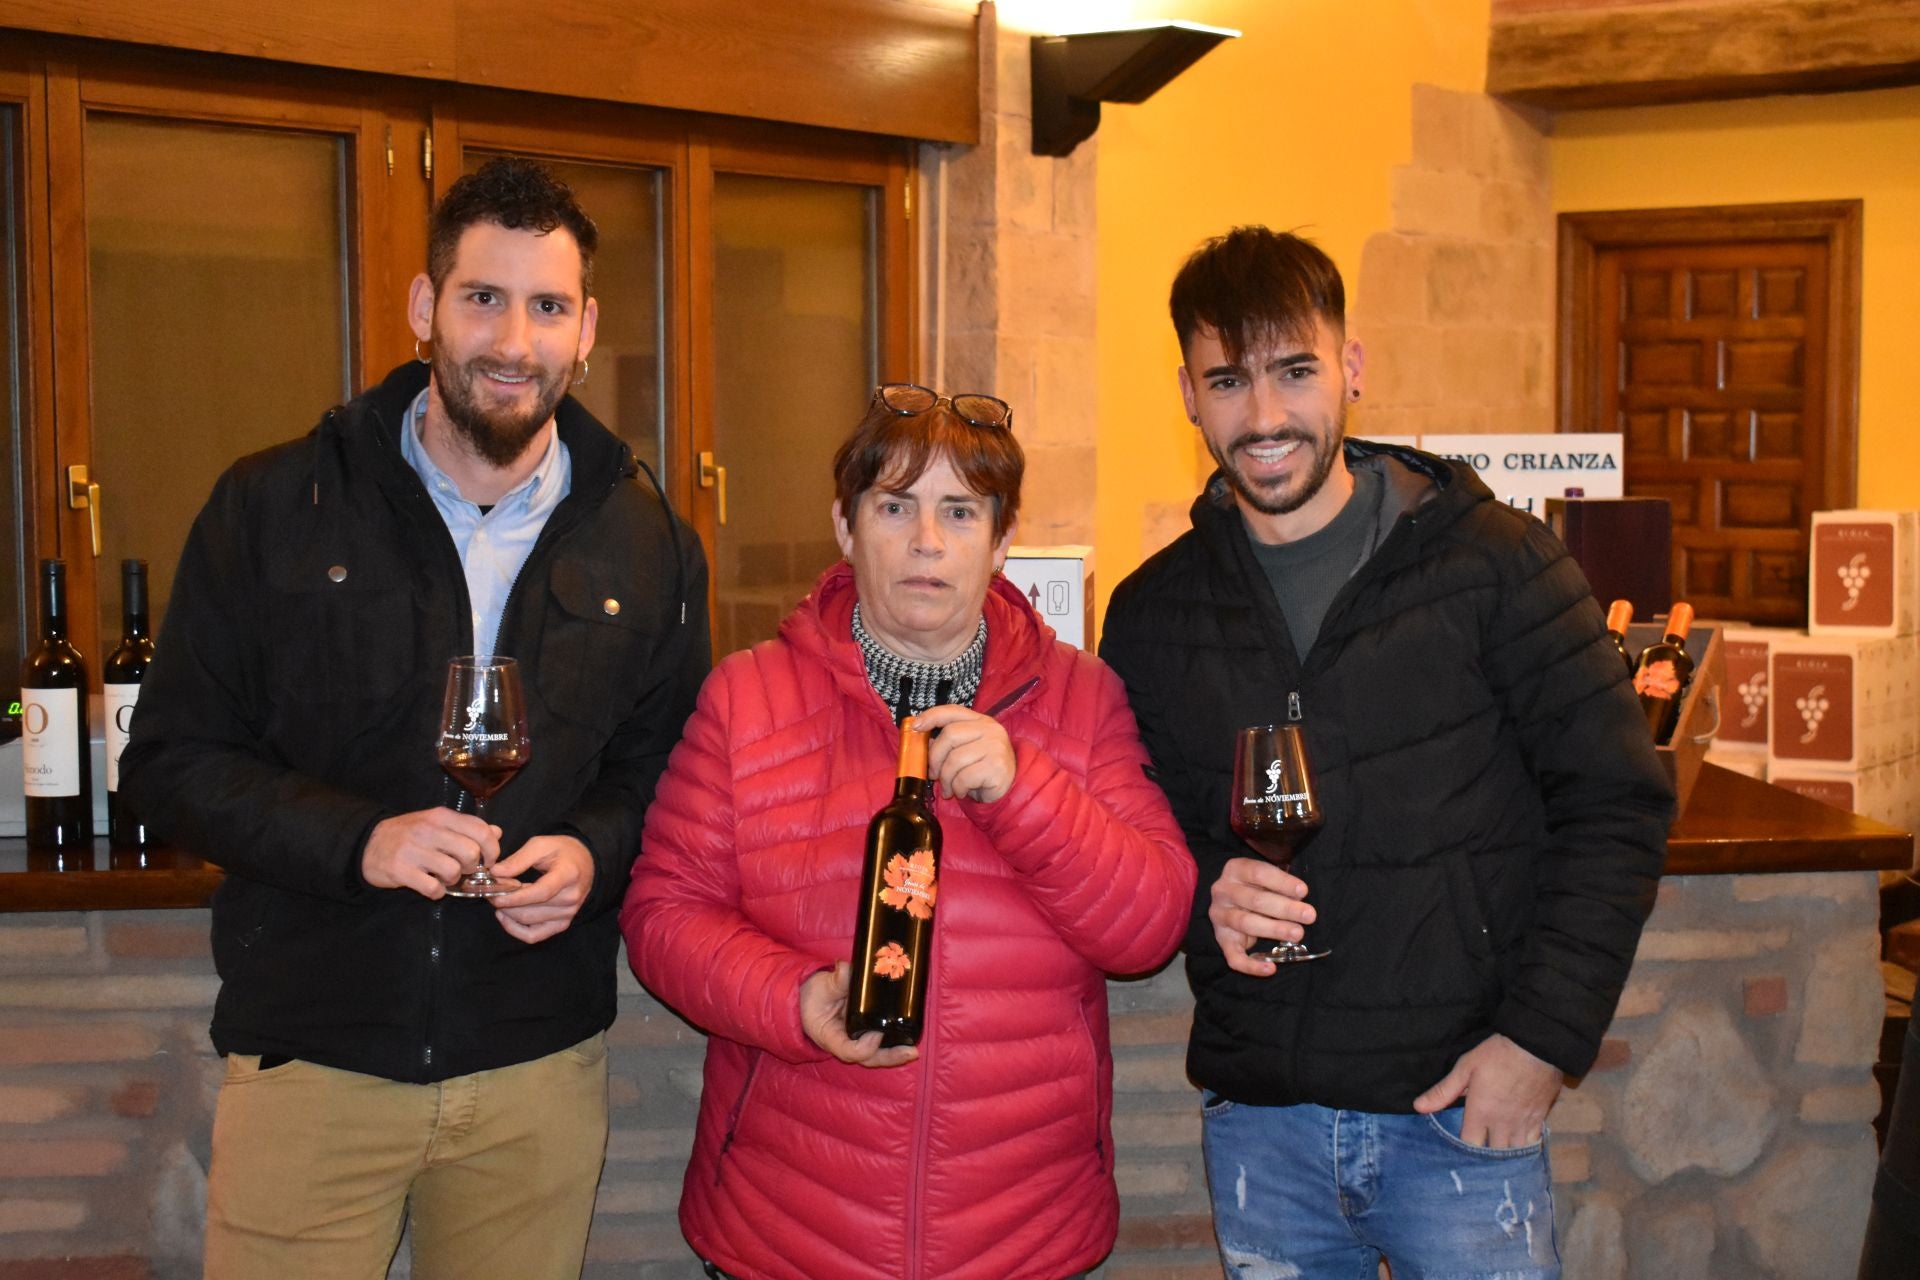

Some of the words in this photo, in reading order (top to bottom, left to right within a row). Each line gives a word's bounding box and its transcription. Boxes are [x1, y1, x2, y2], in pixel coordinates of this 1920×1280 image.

[1503, 453, 1617, 470] CRIANZA
[463, 733, 508, 741] NOVIEMBRE
[1265, 793, 1309, 803] NOVIEMBRE
